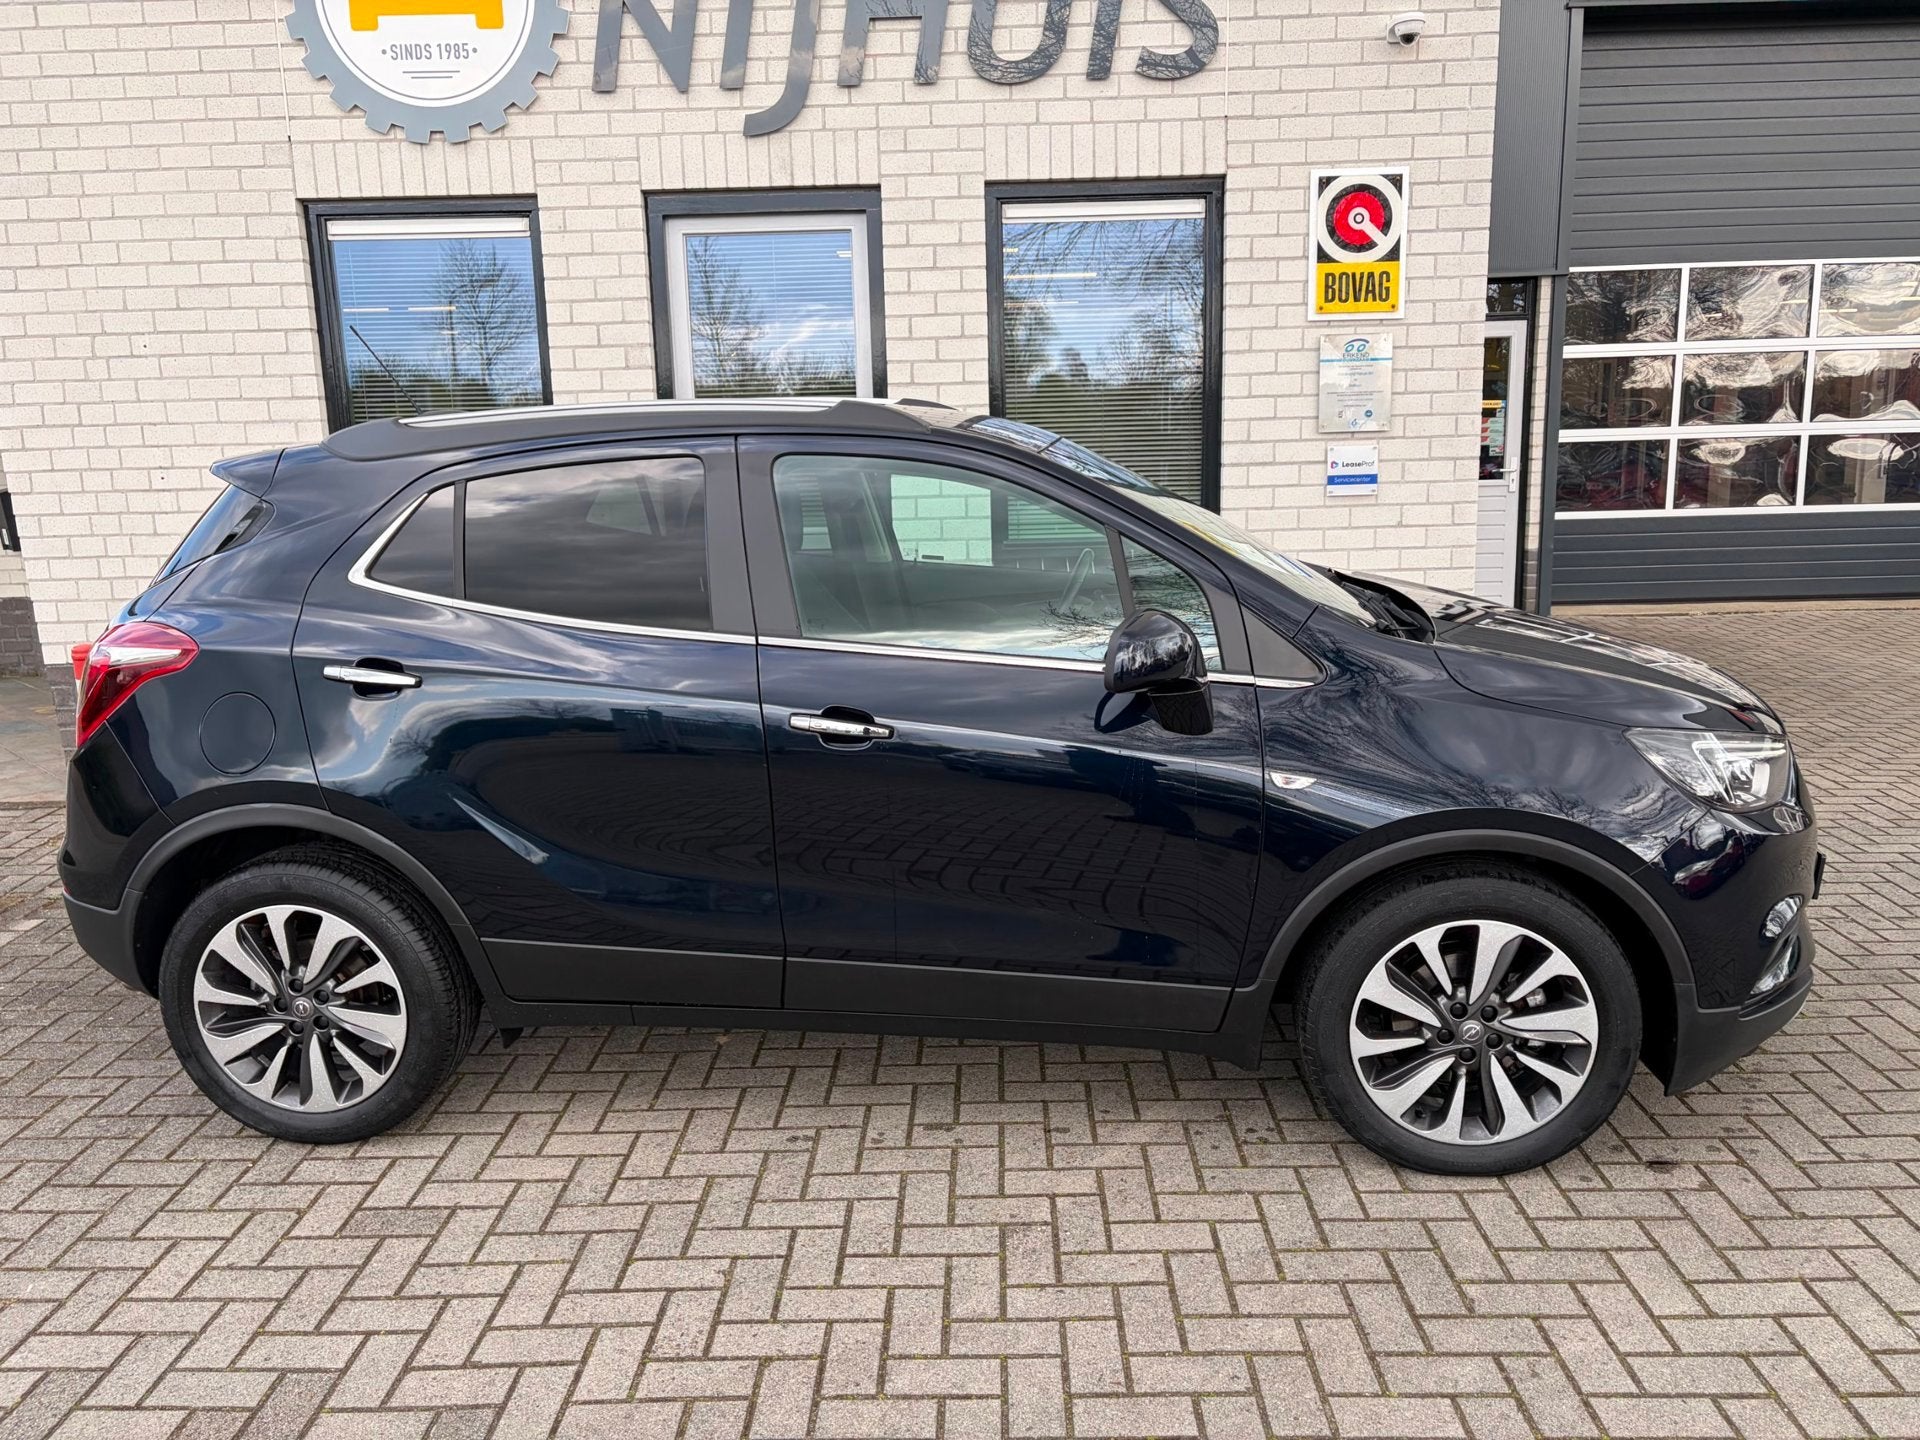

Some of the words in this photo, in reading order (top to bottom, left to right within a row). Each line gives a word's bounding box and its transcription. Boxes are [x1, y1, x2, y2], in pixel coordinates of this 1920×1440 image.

[390, 43, 432, 60] SINDS
[436, 43, 469, 60] 1985
[1324, 271, 1391, 303] BOVAG
[1341, 460, 1375, 468] LeaseProf
[1333, 476, 1371, 484] Servicecenter
